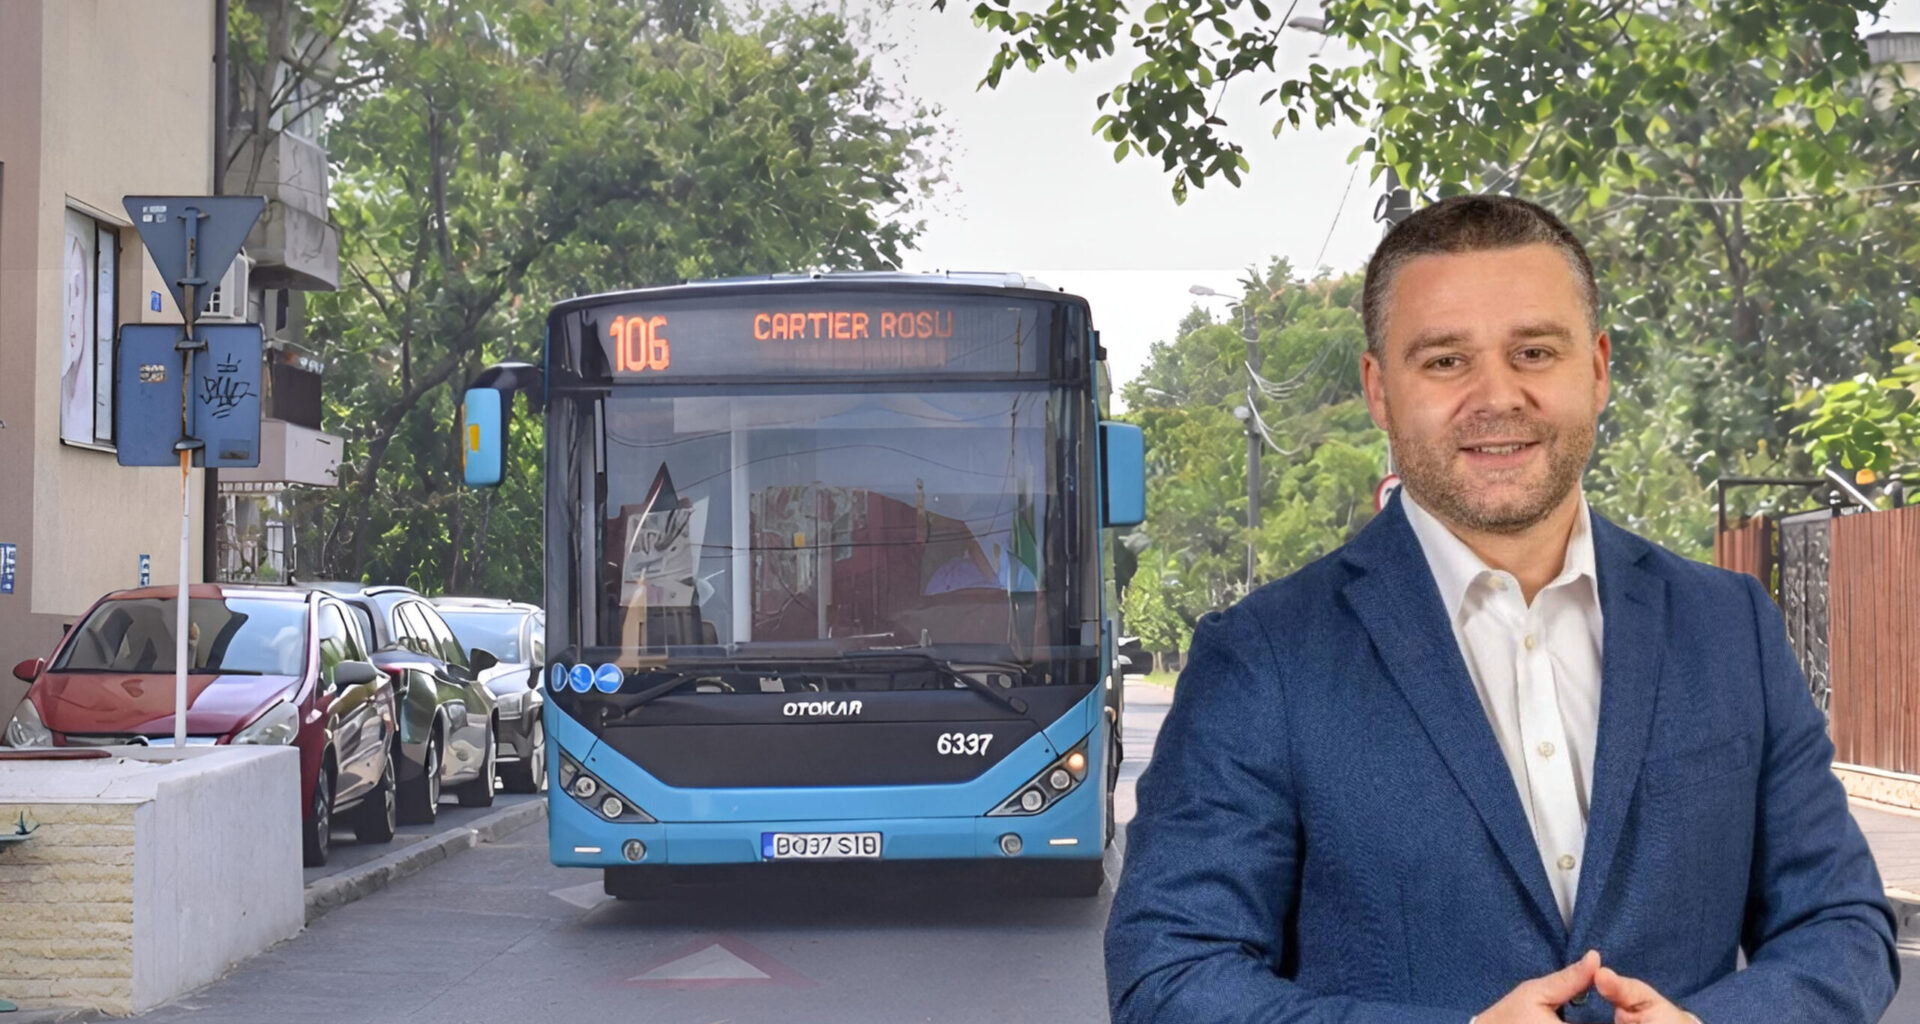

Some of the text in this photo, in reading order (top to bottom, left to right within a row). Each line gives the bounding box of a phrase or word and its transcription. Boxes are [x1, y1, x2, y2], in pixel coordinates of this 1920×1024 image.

[753, 311, 953, 340] CARTIER ROSU
[609, 315, 670, 372] 106
[783, 700, 863, 716] OTOKAR
[936, 732, 994, 757] 6337
